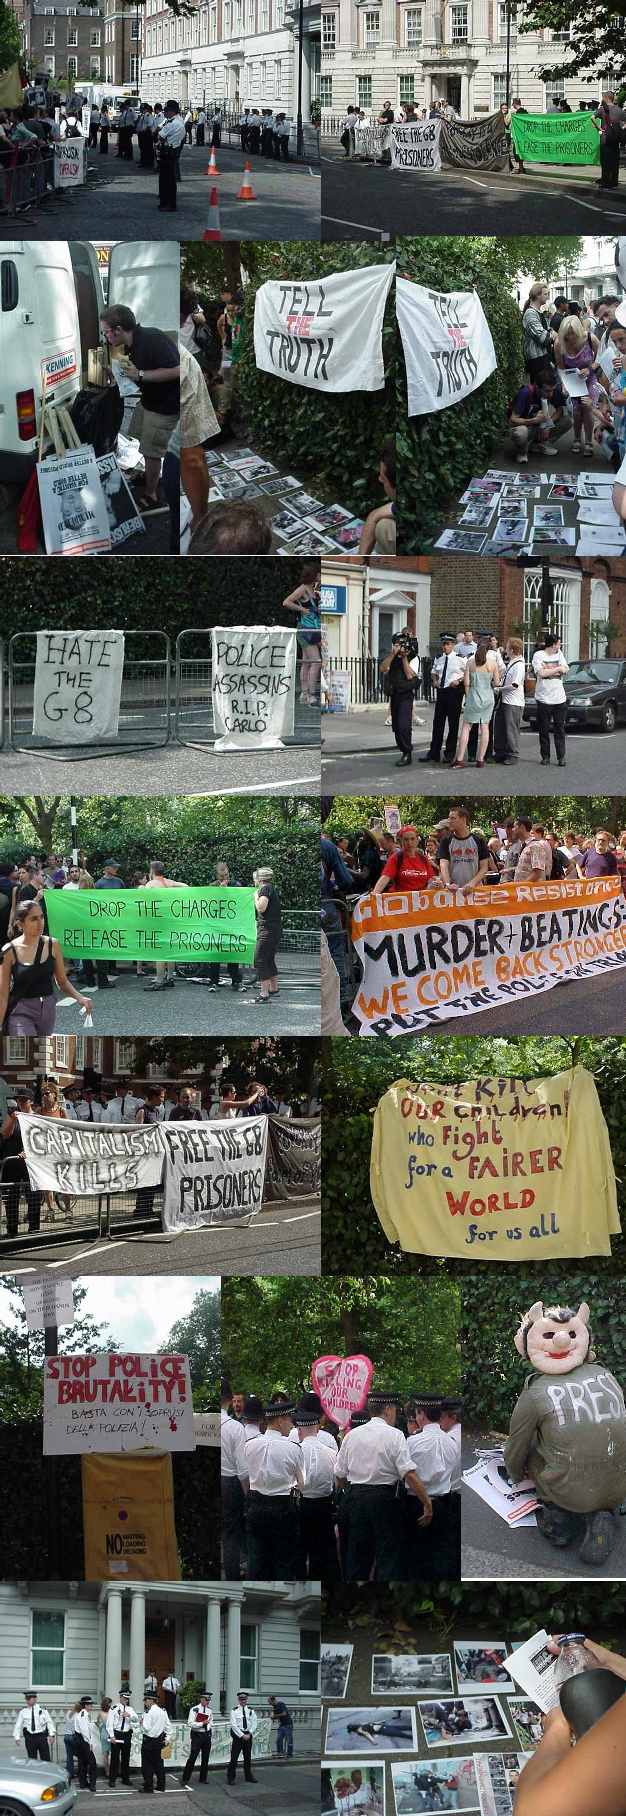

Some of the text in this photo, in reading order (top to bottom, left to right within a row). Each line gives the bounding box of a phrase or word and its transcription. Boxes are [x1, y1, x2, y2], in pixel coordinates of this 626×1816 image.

[411, 126, 423, 144] THE
[556, 119, 587, 133] CHARGES
[394, 146, 435, 167] PRISONERS
[556, 141, 593, 155] PRISONERS
[279, 285, 333, 318] TELL
[428, 293, 468, 329] TELL
[285, 315, 315, 337] THE
[448, 328, 467, 349] THE
[45, 354, 73, 374] KENNING
[266, 330, 334, 381] TRUTH
[431, 348, 478, 398] TRUTH
[44, 635, 118, 667] HATE
[216, 642, 287, 669] POLICE
[53, 671, 93, 689] THE
[213, 673, 292, 697] ASSASSINS
[43, 691, 94, 724] G8
[224, 717, 267, 734] CARLO
[90, 899, 238, 920] DROP THE CHARGES
[63, 929, 247, 953] RELEASE THE PRISONERS
[358, 982, 409, 1021] WE
[415, 961, 486, 1006] COME
[495, 950, 548, 981] BACK
[451, 987, 498, 1012] THE
[27, 1124, 162, 1157] CAPITALISM
[165, 1129, 214, 1165] FREE
[210, 1127, 243, 1162] THE
[408, 1120, 504, 1162] who Fight
[55, 1160, 139, 1193] KILLS
[405, 1154, 438, 1189] for
[441, 1164, 454, 1179] a
[179, 1167, 262, 1213] PRISONERS
[465, 1212, 560, 1244] for us all
[47, 1356, 97, 1379] STOP
[331, 1386, 348, 1400] OUR
[71, 1408, 107, 1420] BASTA
[112, 1407, 135, 1418] CON
[105, 1533, 123, 1555] NO
